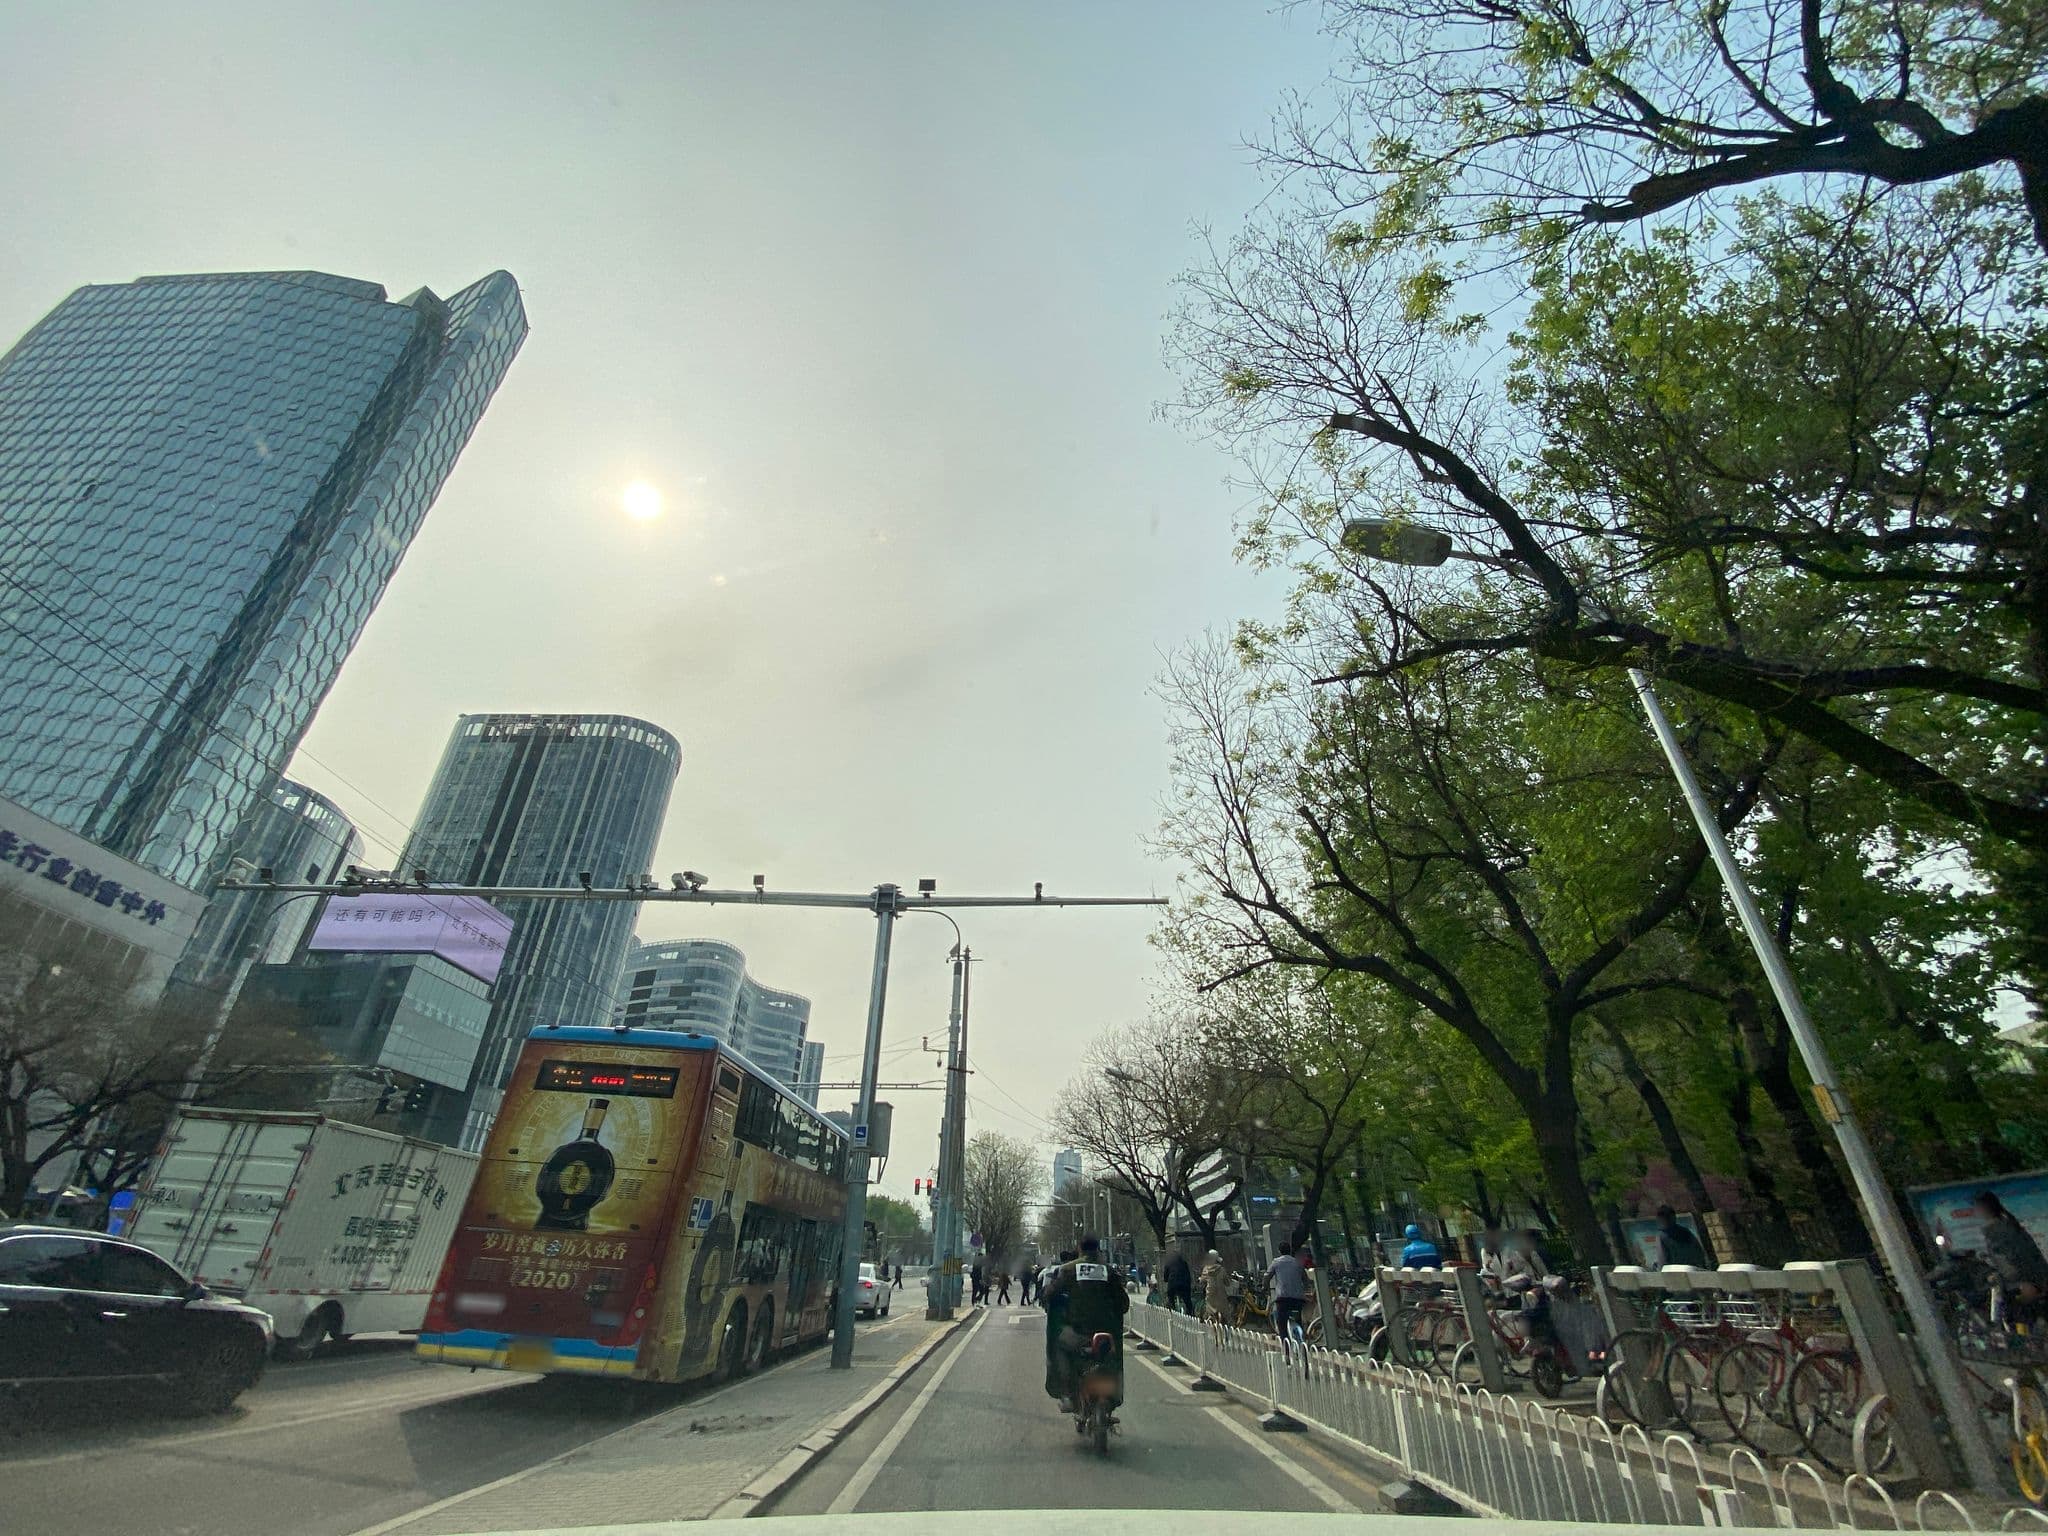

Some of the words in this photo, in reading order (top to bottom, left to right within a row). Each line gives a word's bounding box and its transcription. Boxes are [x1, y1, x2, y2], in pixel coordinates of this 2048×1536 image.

[334, 909, 439, 923] 还有可能吗？
